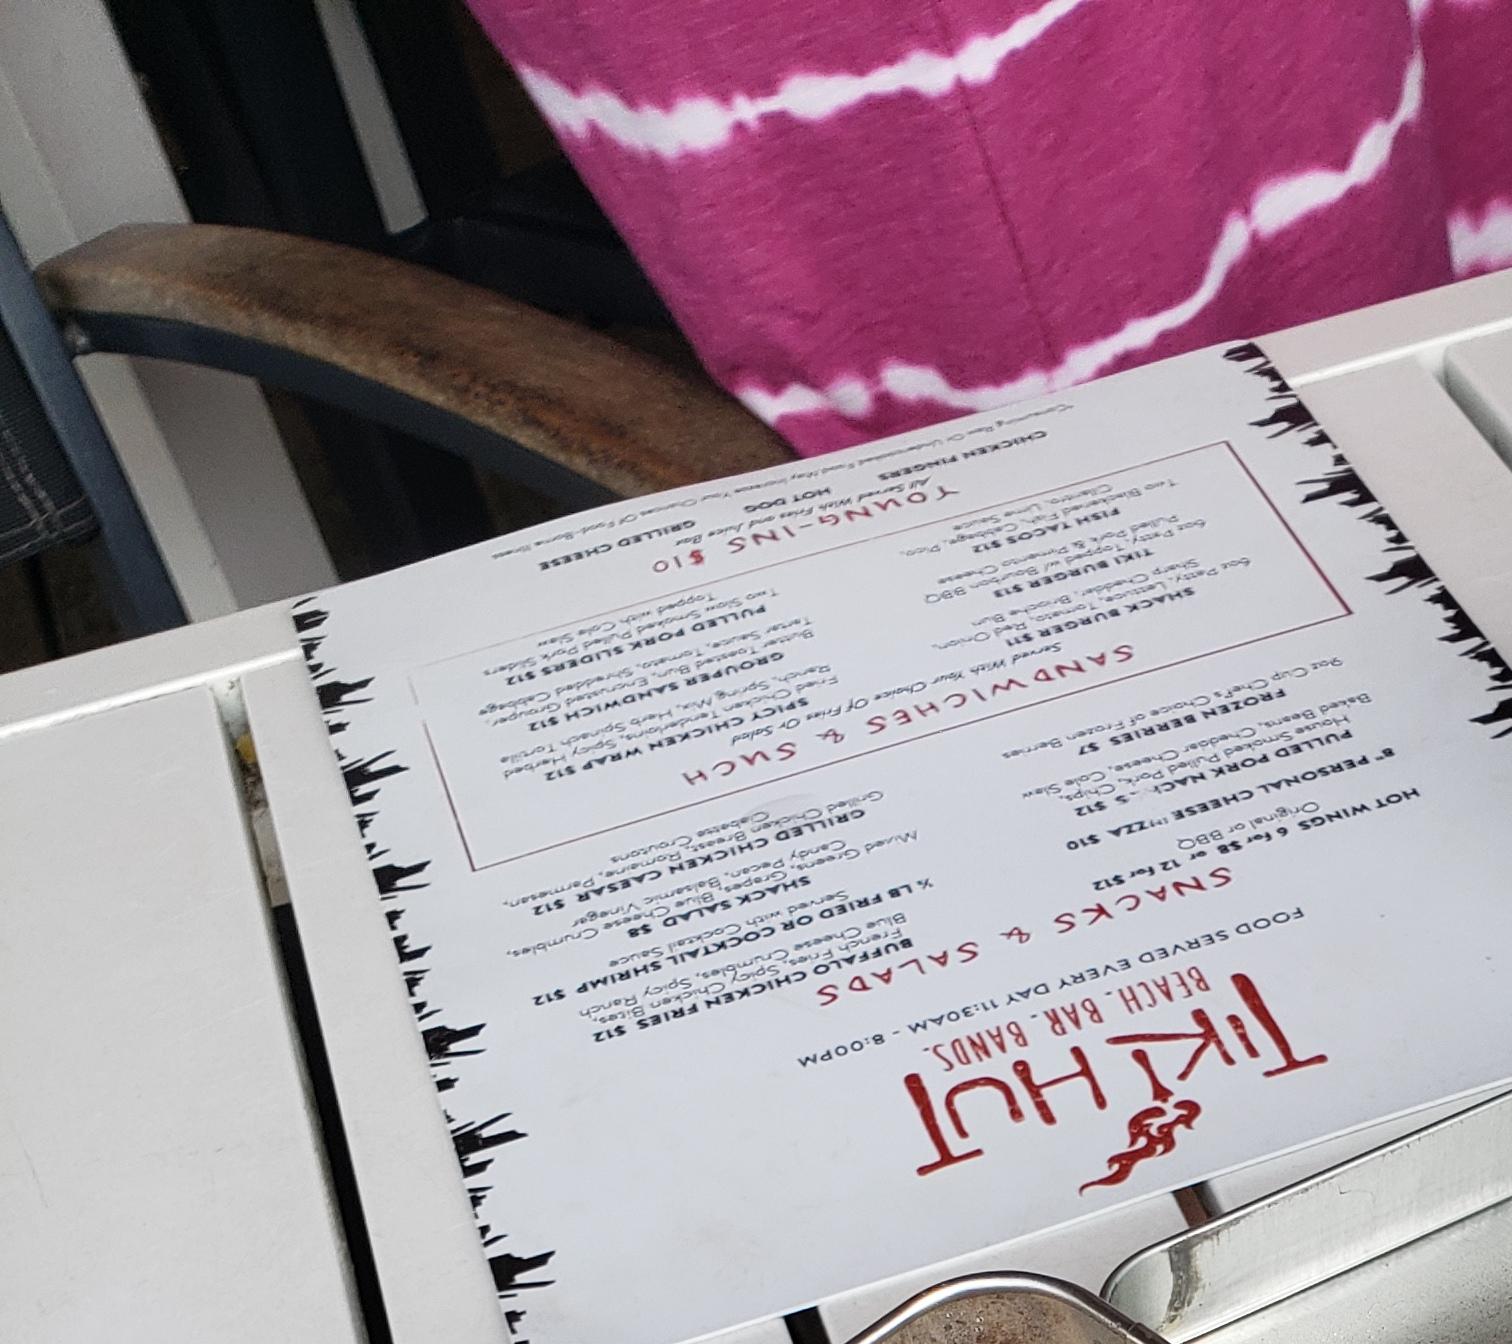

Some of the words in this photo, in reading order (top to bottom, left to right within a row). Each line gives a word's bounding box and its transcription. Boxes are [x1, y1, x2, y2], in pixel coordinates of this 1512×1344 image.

[725, 481, 962, 556] YOUNG-INS
[1072, 505, 1122, 528] FISH
[970, 538, 1004, 555] $12
[1004, 520, 1074, 546] TACOS
[650, 547, 707, 575] $10
[1111, 546, 1156, 567] TIKI
[1025, 558, 1111, 590] BURGER
[1122, 585, 1197, 615] SHACK
[689, 602, 768, 634] PULLED
[1035, 607, 1123, 639] BURGER
[626, 626, 687, 653] PORK
[1003, 631, 1036, 649] $11
[538, 644, 626, 678] SLIDERS
[682, 650, 786, 688] GROUPER
[503, 669, 538, 687] $12
[864, 643, 1136, 737] SANDWICHES
[562, 680, 681, 724] SANDWICH
[749, 695, 811, 723] SPICY
[1198, 686, 1289, 721] FROZEN
[526, 714, 561, 733] $12
[646, 715, 747, 753] CHICKEN
[814, 727, 847, 746] &
[1107, 712, 1199, 748] BERRIES
[580, 745, 645, 772] WRAP
[1076, 740, 1102, 757] $7
[1272, 727, 1355, 760] PULLED
[542, 763, 578, 783] $12
[680, 740, 798, 787] SUCH
[1207, 751, 1272, 780] PORK
[1254, 753, 1372, 795] PERSONAL
[1112, 770, 1209, 806] NACS
[1373, 786, 1422, 810] HOT
[1072, 799, 1109, 818] $12
[1169, 788, 1256, 822] CHEESE
[1247, 800, 1322, 831] Original
[1295, 802, 1374, 832] WINGS
[772, 807, 867, 843] GRILLED
[1175, 828, 1226, 852] BBQ
[1274, 825, 1290, 839] 6
[666, 836, 771, 876] CHICKEN
[1064, 832, 1103, 852] $10
[1214, 838, 1245, 856] $8
[1157, 857, 1184, 873] 12
[574, 868, 664, 904] CAESAR
[733, 874, 813, 908] SHACK
[885, 882, 915, 900] LB
[1090, 873, 1128, 893] $12
[530, 897, 567, 918] $12
[660, 898, 734, 929] SALAD
[816, 891, 885, 921] FRIED
[1052, 865, 1234, 935] SNACKS
[625, 922, 655, 940] $8
[778, 913, 816, 933] OR
[998, 925, 1032, 946] &
[1233, 905, 1306, 936] FOOD
[663, 924, 778, 967] COCKTAIL
[810, 936, 916, 977] BUFFALO
[1136, 928, 1231, 965] SERVED
[574, 959, 664, 995] SHRIMP
[814, 940, 981, 1008] SALADS
[1057, 956, 1134, 991] EVERY
[530, 987, 568, 1008] $12
[702, 969, 809, 1011] CHICKEN
[1004, 981, 1052, 1007] DAY
[634, 1001, 701, 1032] FRIES
[905, 997, 1001, 1036] 11:30AM
[590, 1023, 629, 1044] $12
[1104, 971, 1330, 1103] TIKI
[795, 1032, 887, 1070] 8:00PM
[903, 1045, 1108, 1177] HUT
